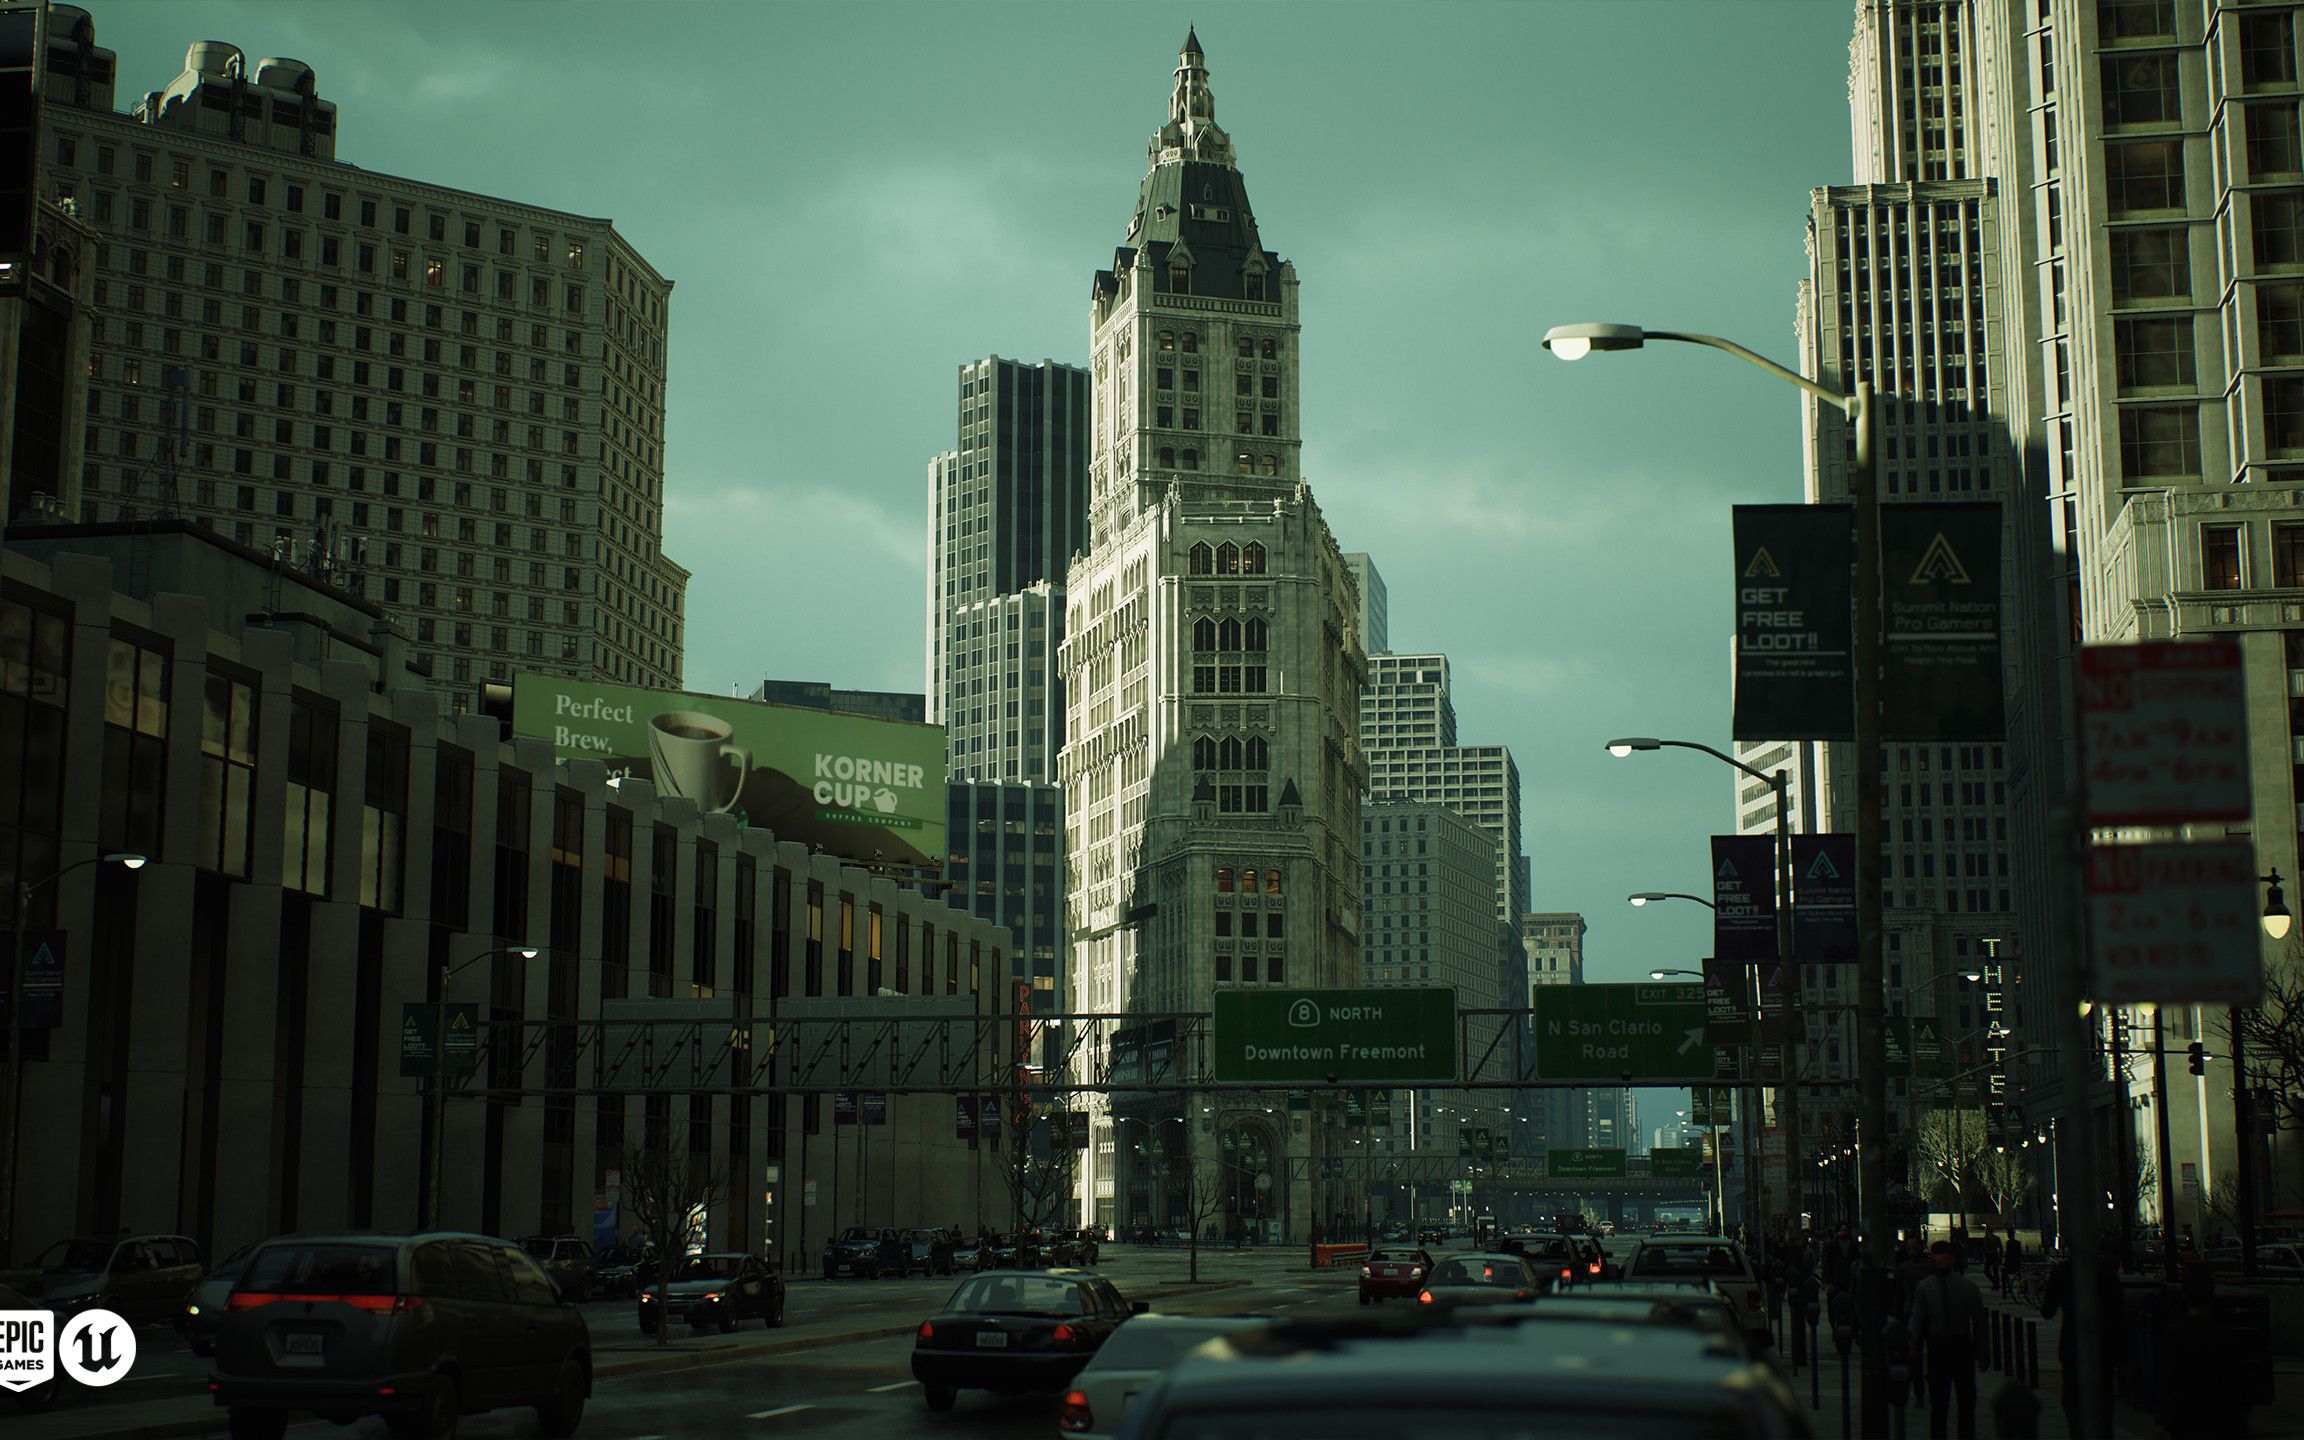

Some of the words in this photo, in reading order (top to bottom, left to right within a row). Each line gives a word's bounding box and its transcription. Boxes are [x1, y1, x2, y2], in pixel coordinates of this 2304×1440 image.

[1742, 588, 1789, 605] GET
[1892, 601, 1946, 614] Summit
[1950, 601, 1997, 613] Nation
[1742, 611, 1804, 627] FREE
[1895, 616, 1922, 631] Pro
[1927, 616, 1993, 630] Gamers
[555, 694, 634, 724] Perfect
[555, 725, 613, 754] Brew,
[815, 753, 924, 789] KORNER
[813, 780, 871, 808] CUP
[825, 812, 862, 822] COFFEE
[868, 817, 912, 827] COMPANY
[1717, 881, 1742, 890] GET
[1718, 893, 1751, 903] FREE
[1641, 989, 1667, 1000] EXIT
[1676, 986, 1706, 1000] 325
[1299, 1004, 1310, 1021] 8
[1329, 1007, 1383, 1020] NORTH
[1548, 1021, 1561, 1035] N
[1568, 1020, 1601, 1036] San
[1608, 1019, 1663, 1035] Clario
[1982, 938, 2006, 1106] THEATE
[1244, 1045, 1334, 1061] Downtown
[1340, 1044, 1426, 1061] Freemont
[1582, 1044, 1629, 1059] Road
